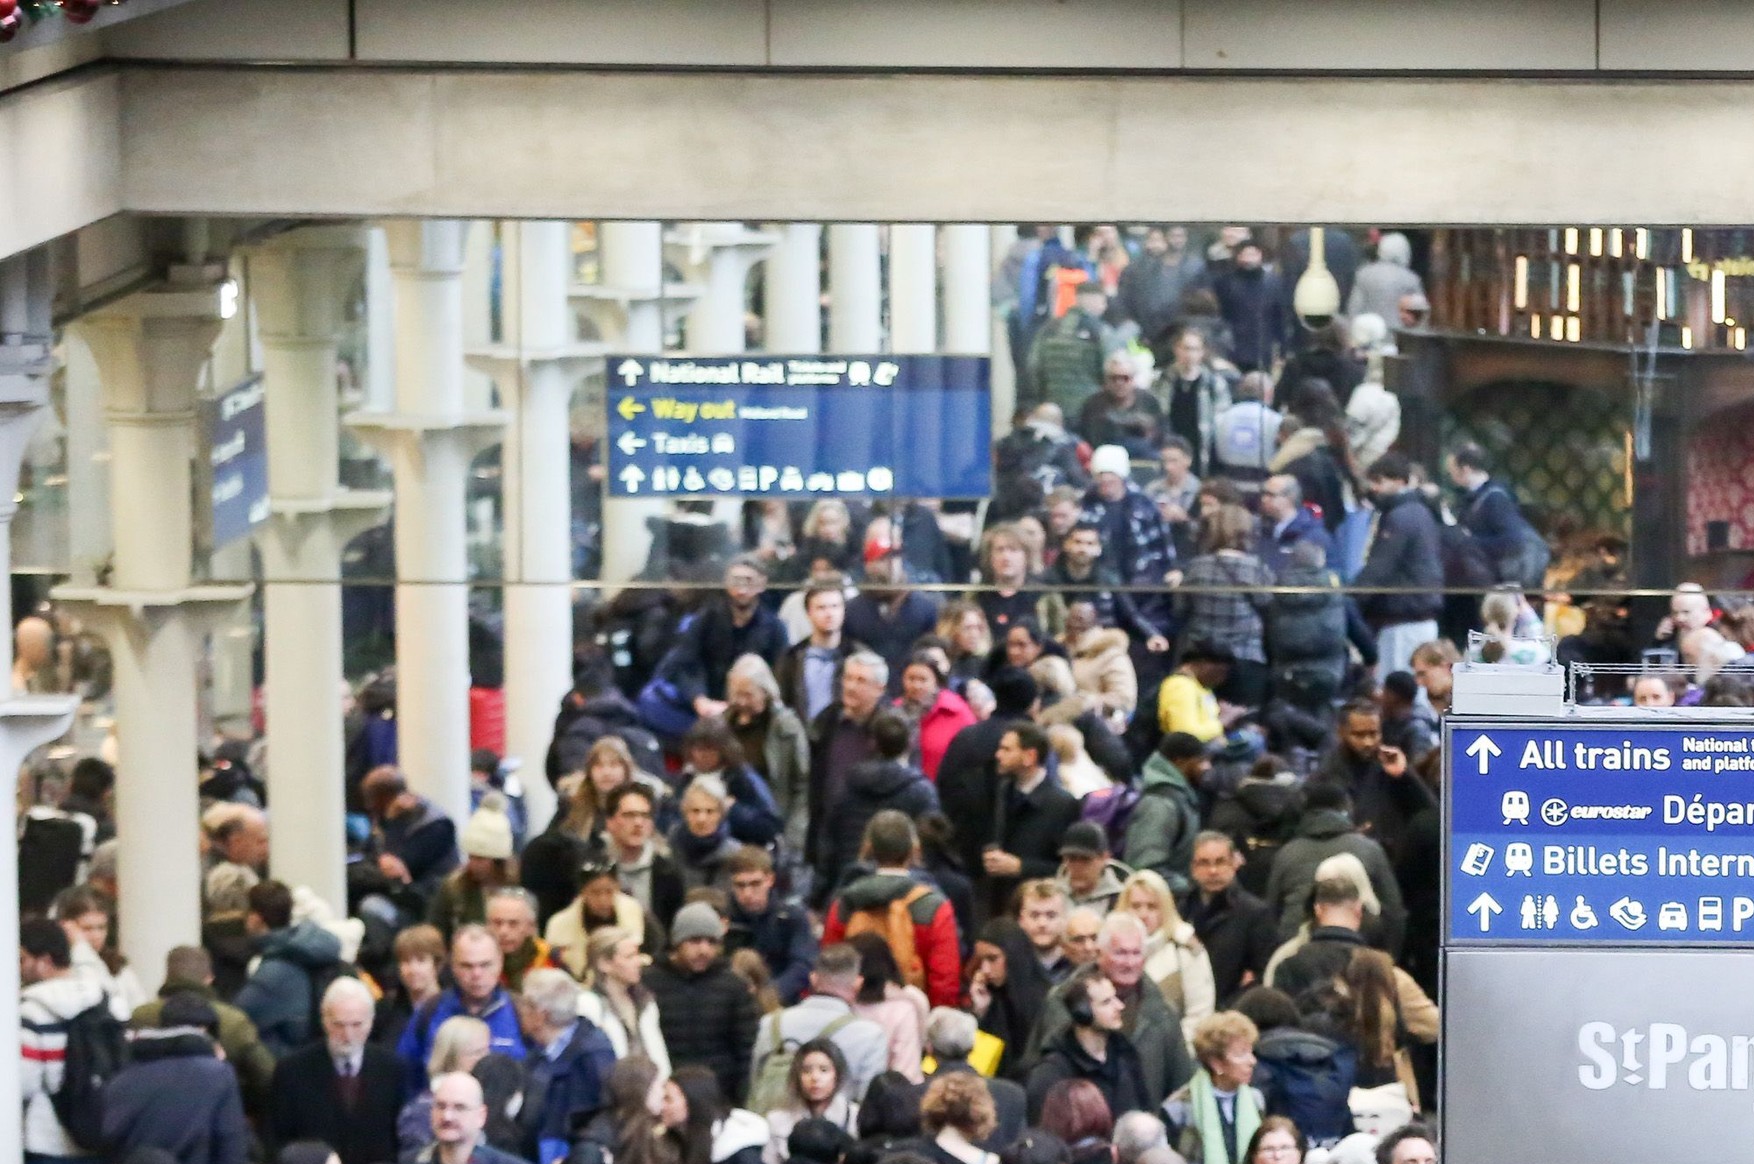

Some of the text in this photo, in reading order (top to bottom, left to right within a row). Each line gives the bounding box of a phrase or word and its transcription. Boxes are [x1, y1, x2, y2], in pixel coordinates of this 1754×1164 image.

[650, 361, 738, 384] National
[741, 361, 784, 384] Rail
[651, 397, 698, 423] Way
[699, 400, 736, 420] out
[652, 432, 709, 454] Taxis
[1520, 740, 1670, 770] All trains
[1683, 737, 1748, 752] National
[1683, 756, 1711, 770] and
[1570, 805, 1652, 819] eurostar
[1544, 846, 1648, 875] Billets
